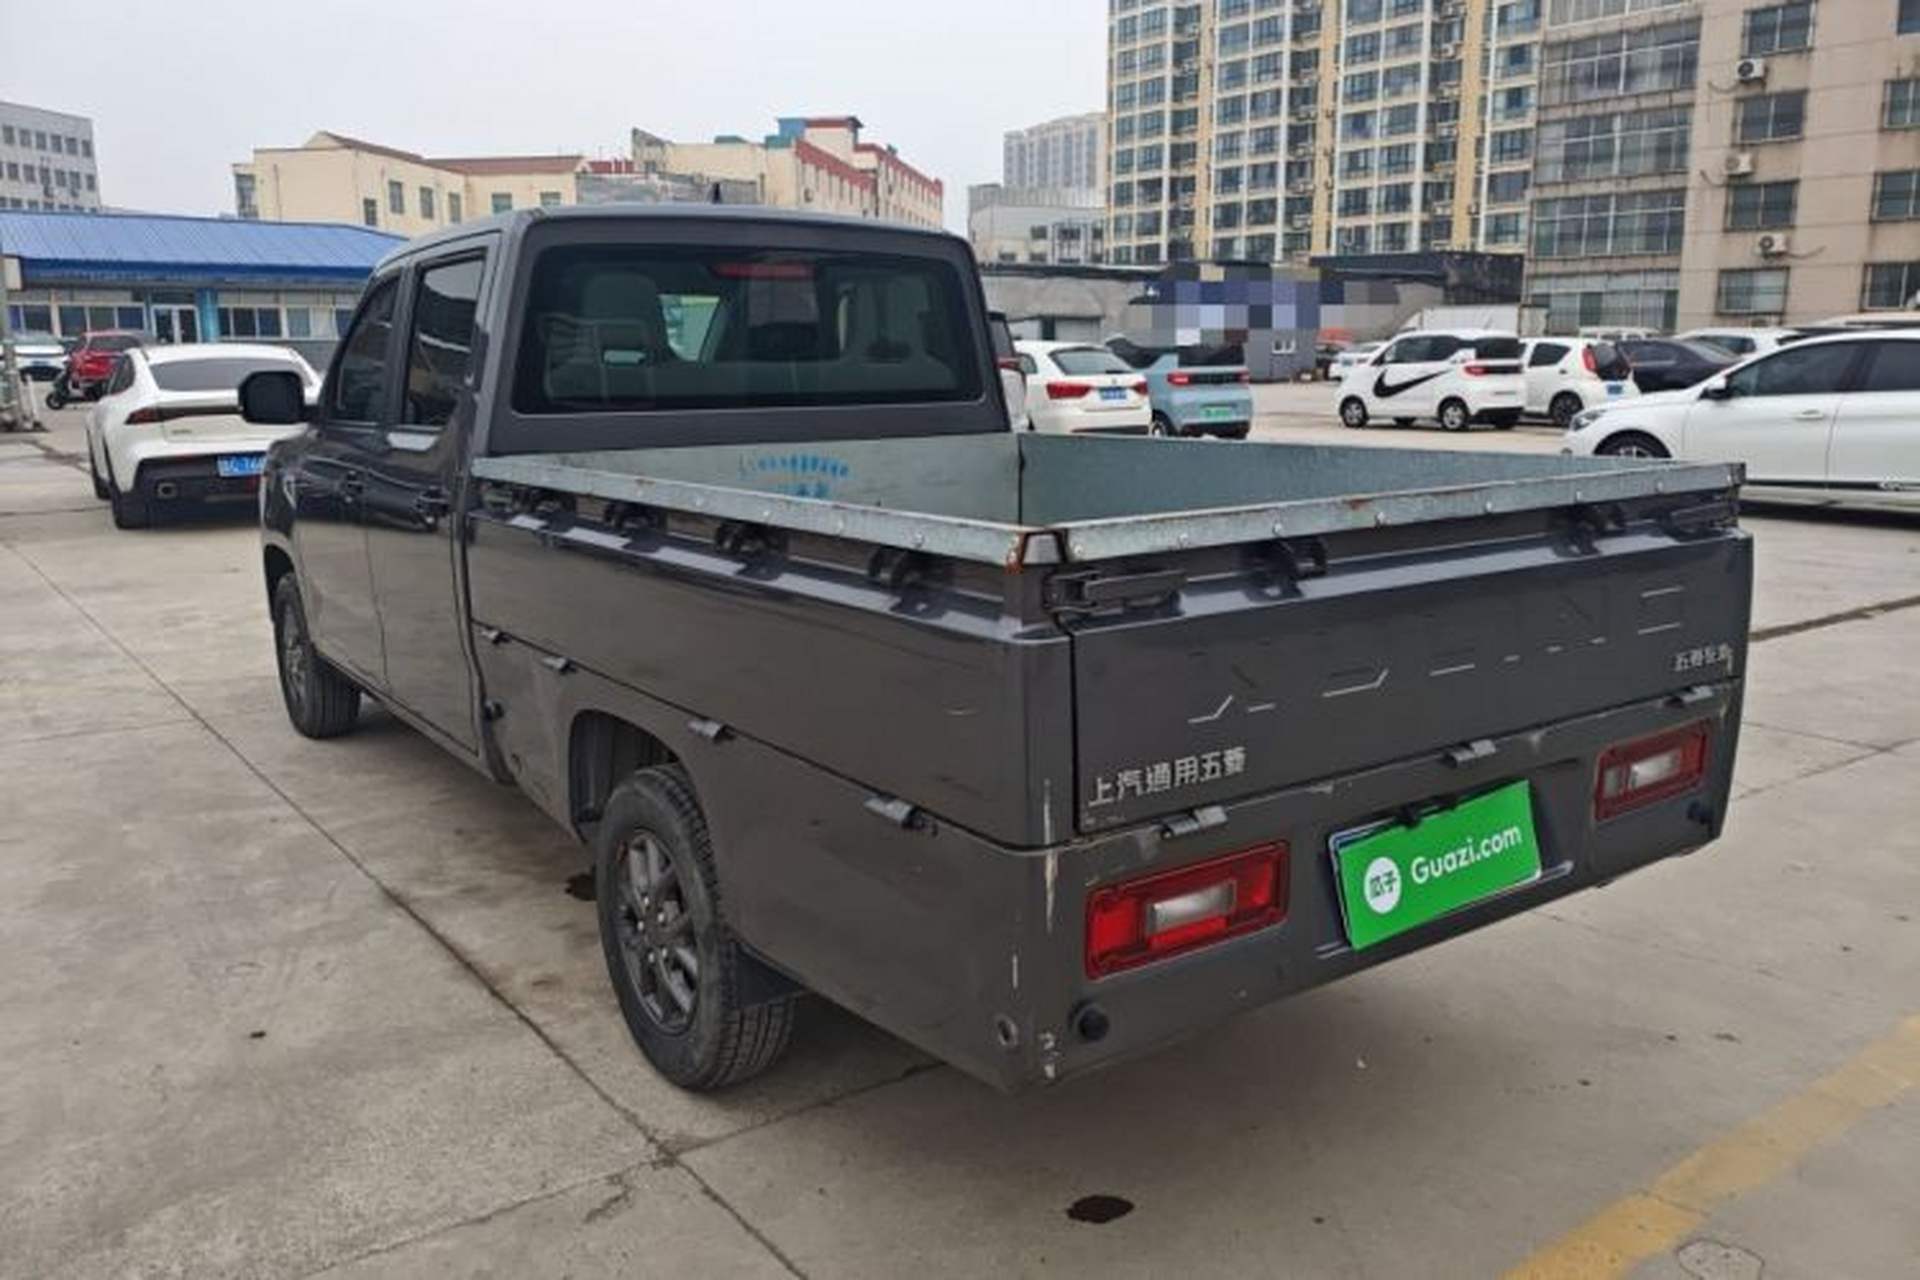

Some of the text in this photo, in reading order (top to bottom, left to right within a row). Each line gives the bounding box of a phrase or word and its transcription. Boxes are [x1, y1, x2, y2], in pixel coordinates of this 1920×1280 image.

[1088, 746, 1246, 807] 上汽通用五菱
[1410, 826, 1522, 884] Guazi.com
